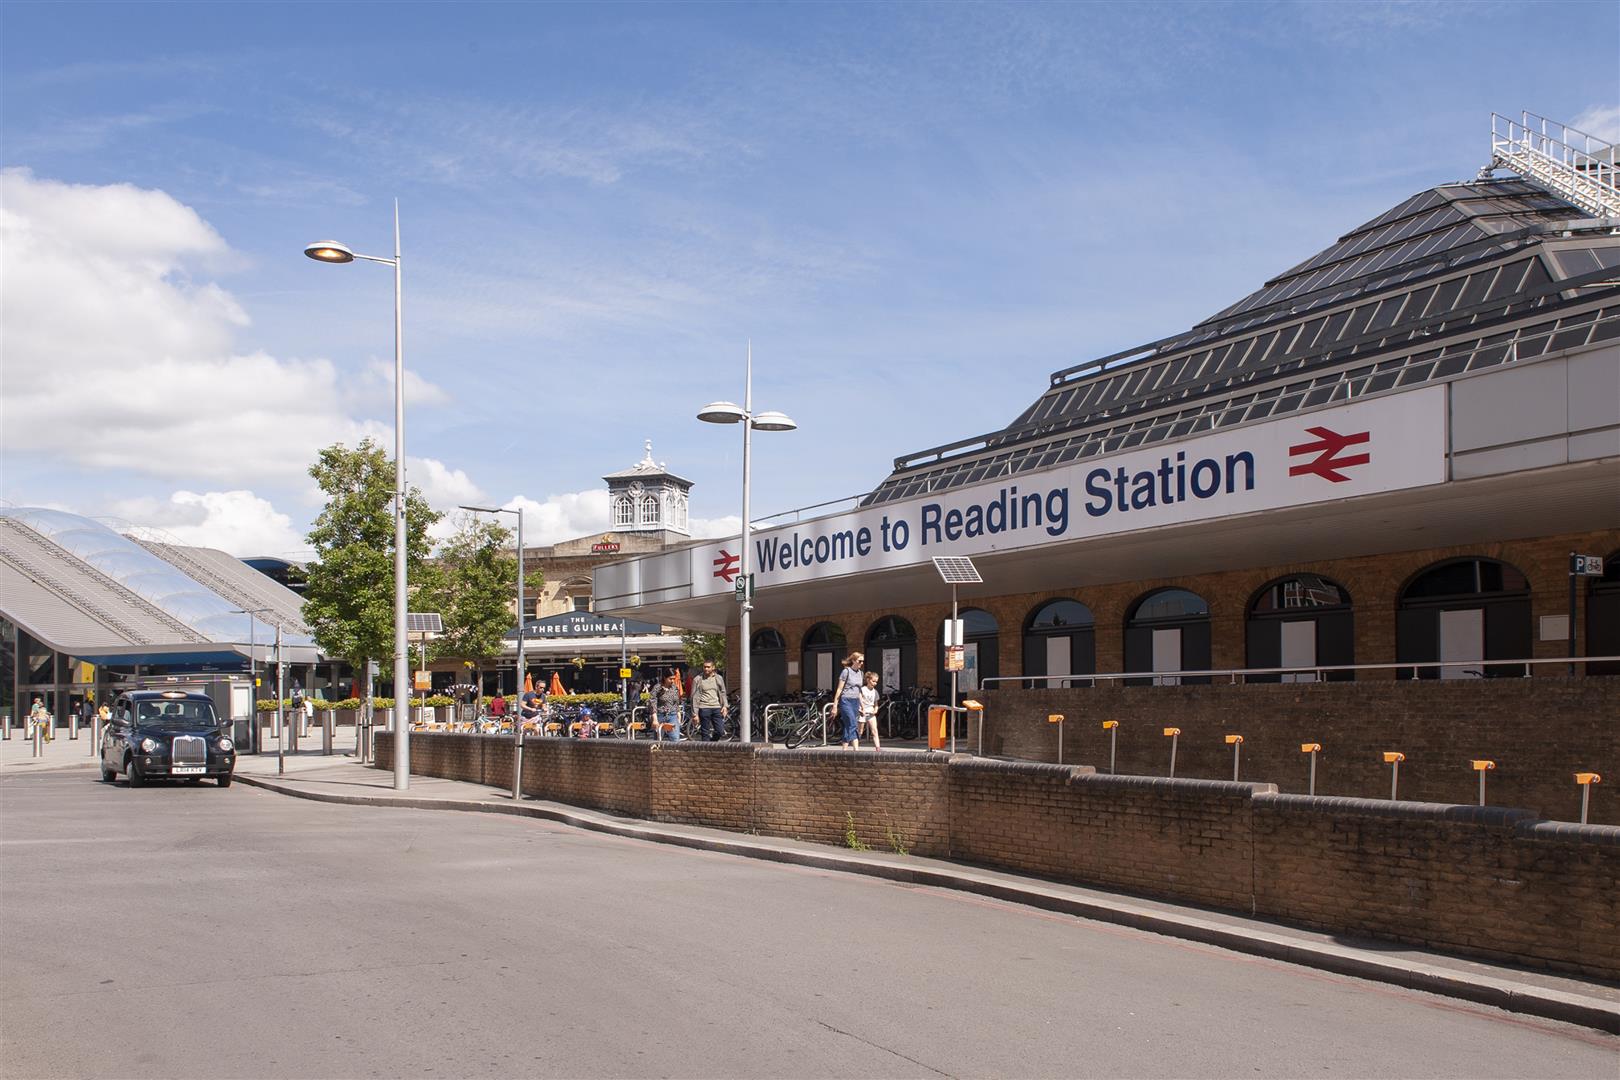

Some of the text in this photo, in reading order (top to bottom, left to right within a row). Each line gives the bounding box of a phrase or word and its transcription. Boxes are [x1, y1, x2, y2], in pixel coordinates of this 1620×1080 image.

[756, 451, 1255, 573] Welcome to Reading Station
[1576, 558, 1584, 571] P
[532, 625, 569, 633] THREE
